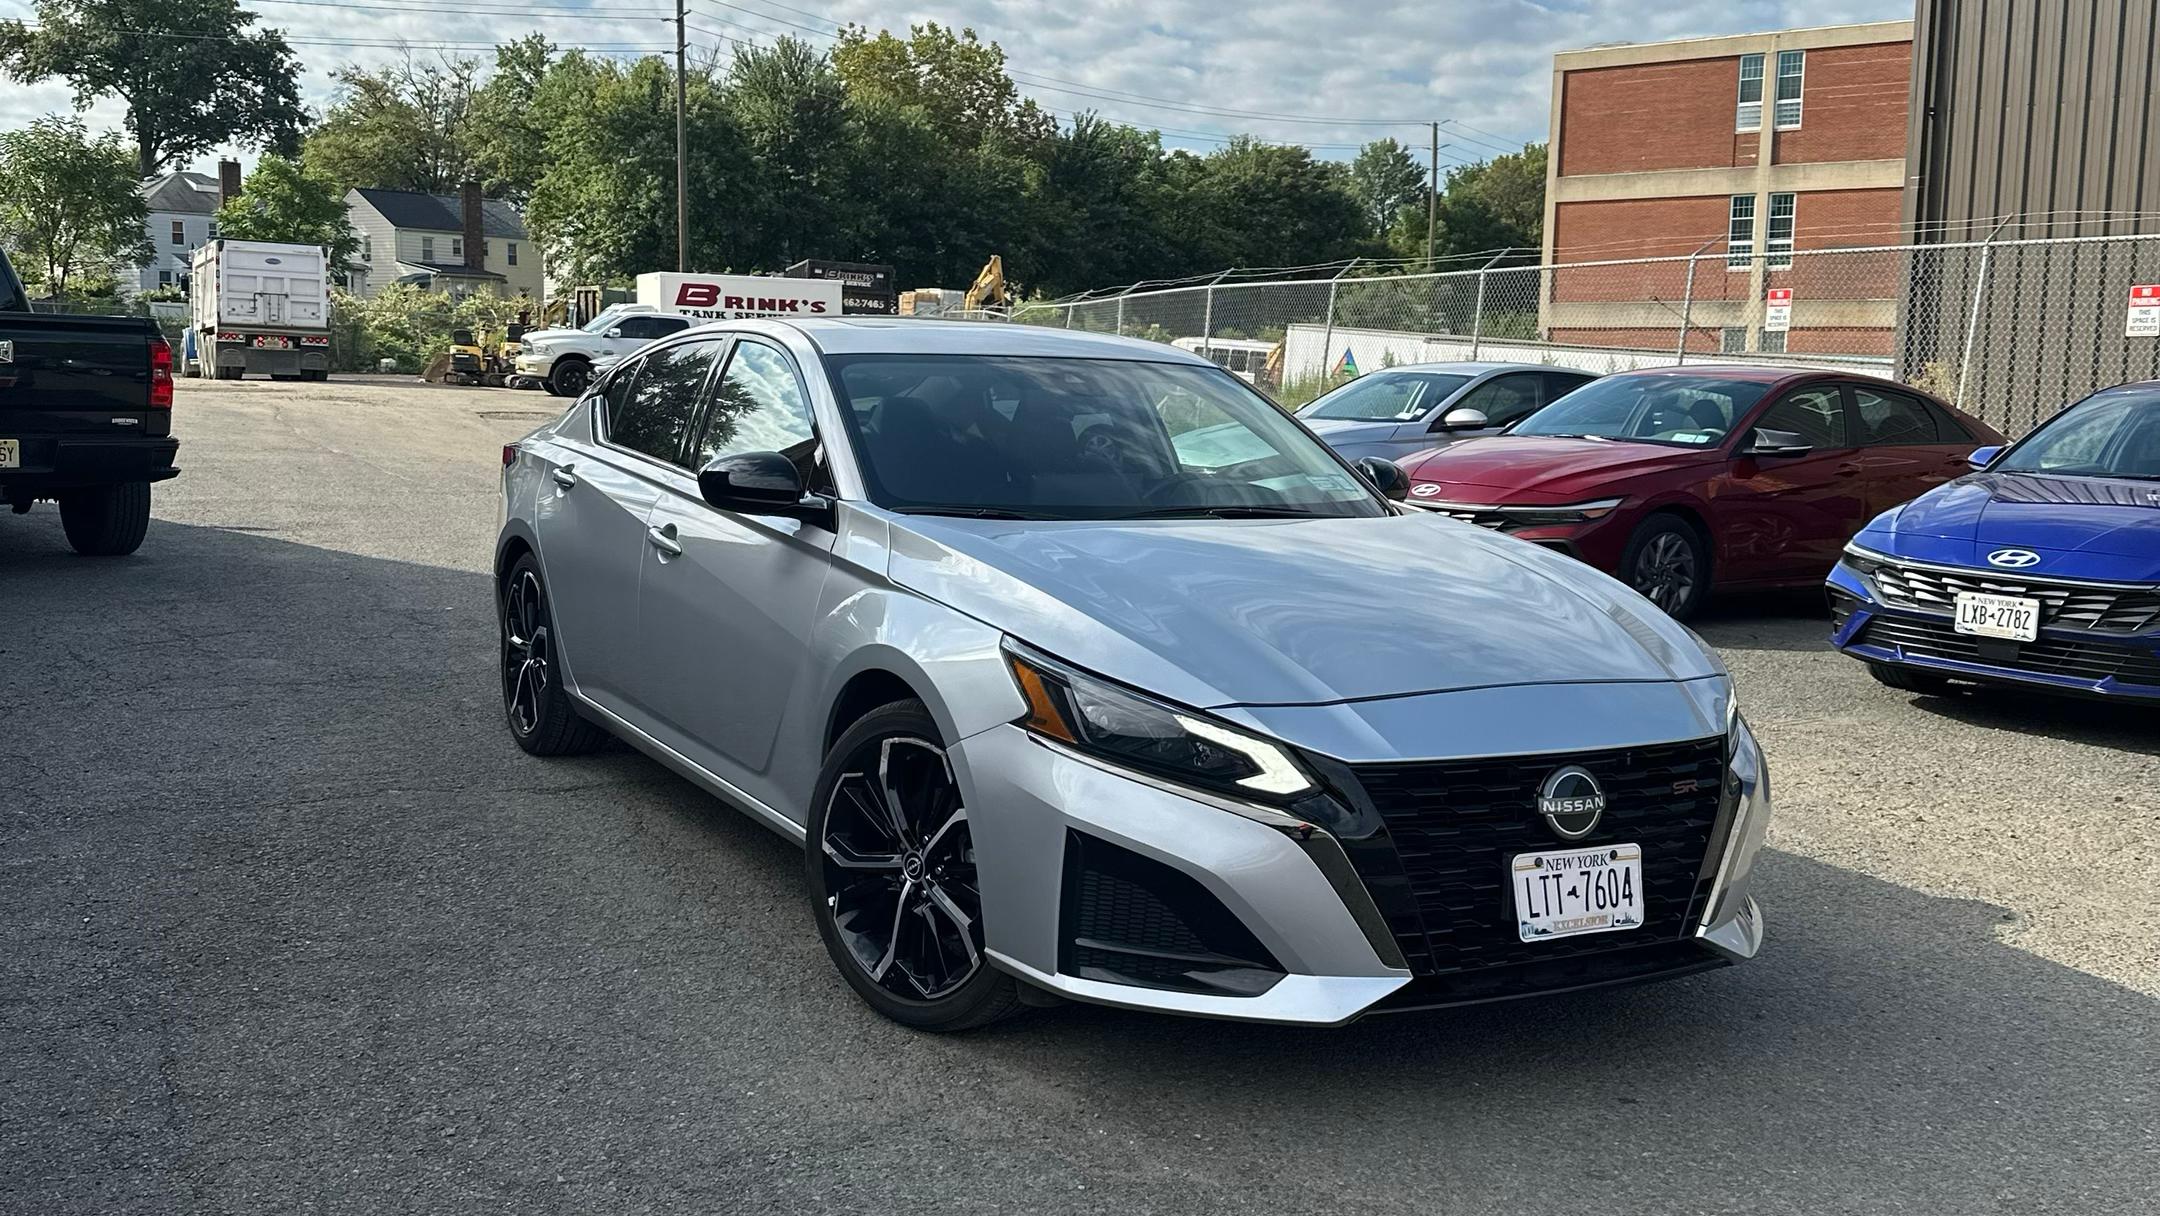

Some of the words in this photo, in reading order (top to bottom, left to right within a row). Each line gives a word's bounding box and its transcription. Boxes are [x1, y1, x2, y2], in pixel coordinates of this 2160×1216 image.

[675, 283, 826, 313] BRINK'S
[679, 309, 726, 319] TANK
[1977, 597, 1996, 605] NEW
[1997, 600, 2018, 608] YORK
[1543, 796, 1604, 812] NISSAN
[1545, 857, 1575, 872] NEW
[1576, 853, 1609, 868] YORK
[1552, 915, 1608, 932] EXCELSIOR
